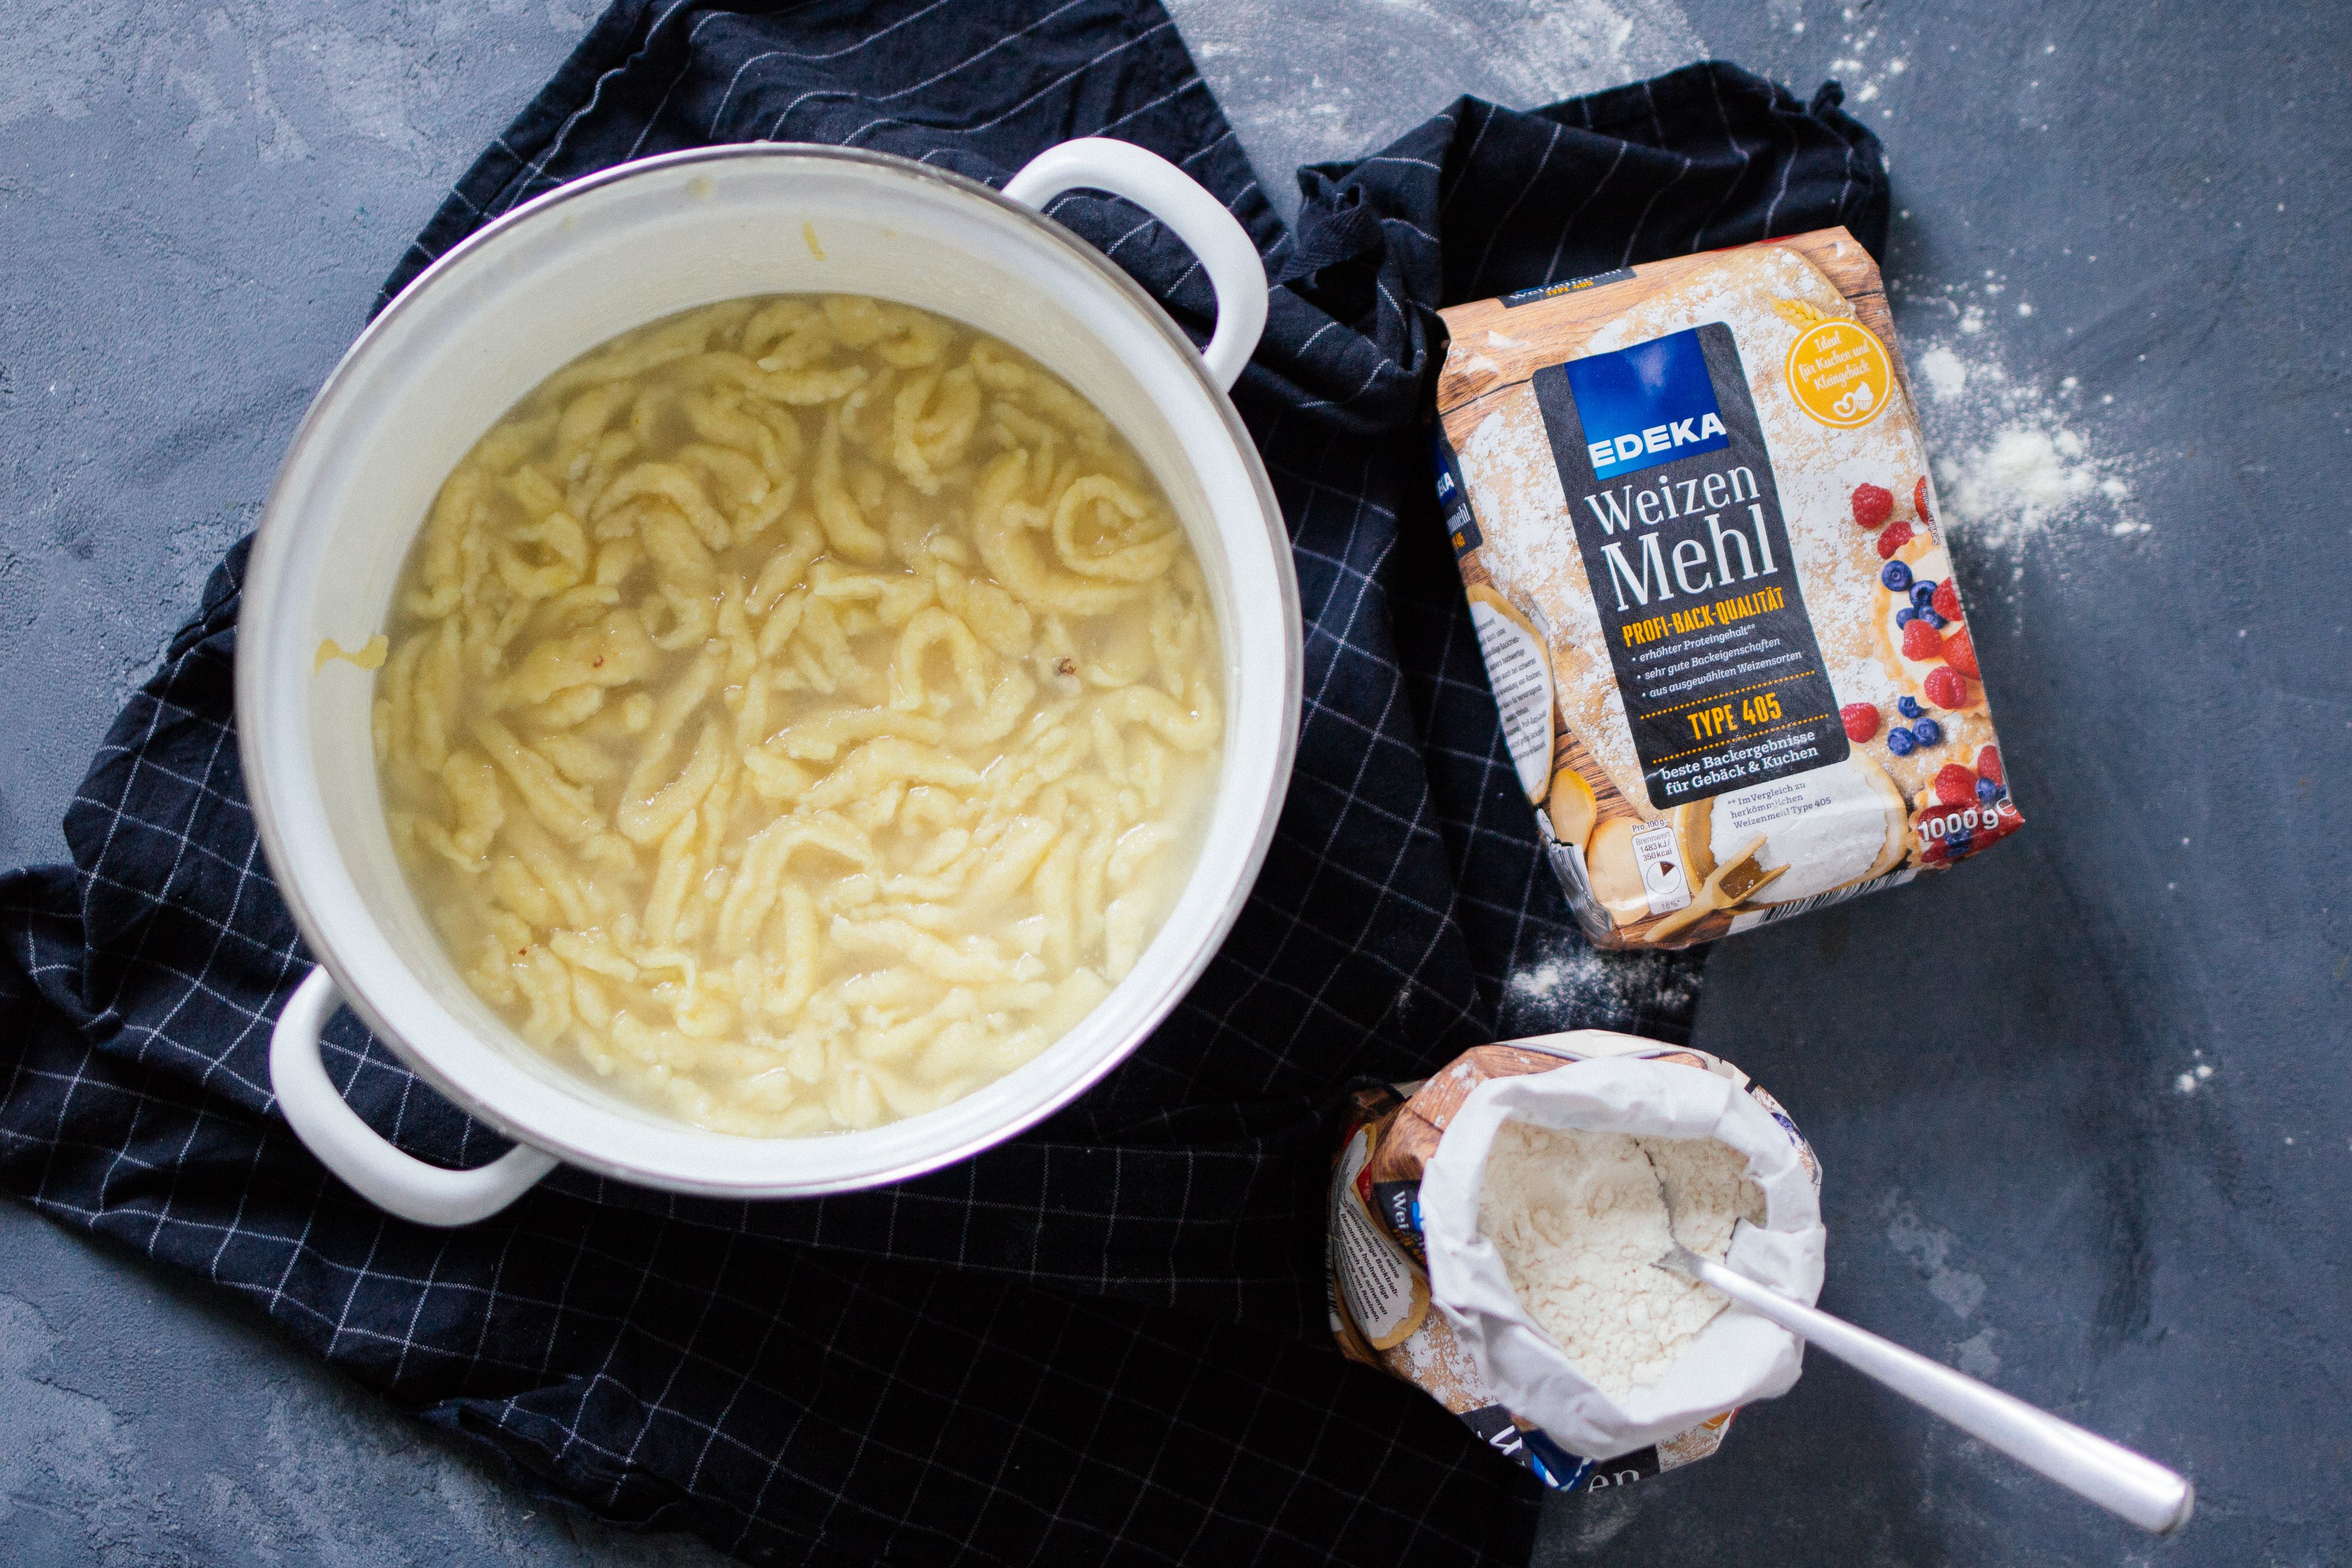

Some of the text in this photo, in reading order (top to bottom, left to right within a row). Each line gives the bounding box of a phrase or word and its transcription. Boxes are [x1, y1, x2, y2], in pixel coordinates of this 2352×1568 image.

[1798, 338, 1871, 383] für Kuchen und
[1814, 330, 1842, 352] Ideal
[1814, 359, 1870, 391] Kleingebäck
[1588, 412, 1728, 469] EDEKA
[1584, 466, 1760, 536] Weizen
[1601, 503, 1778, 611] Mehl
[1622, 586, 1785, 647] PROFI-BACK-QUALITÄT
[1639, 643, 1682, 662] erhöhter
[1645, 637, 1781, 680] sehr gute Backeigenschaften
[1649, 651, 1802, 698] aus ausgewählten Weizensorten
[1687, 692, 1782, 740] TYPE 405
[1661, 731, 1816, 781] beste Backergebnisse
[1665, 745, 1819, 796] für Gebäck & Kuchen
[1790, 801, 1813, 814] Type
[1814, 797, 1832, 808] 405
[1635, 831, 1671, 846] Brennwert
[1358, 1266, 1368, 1279] bei
[1365, 1279, 1388, 1315] schweren
[1362, 1252, 1389, 1299] hochwertige
[1375, 1258, 1399, 1298] Backtrieb-
[1361, 1289, 1380, 1323] Rosinen,
